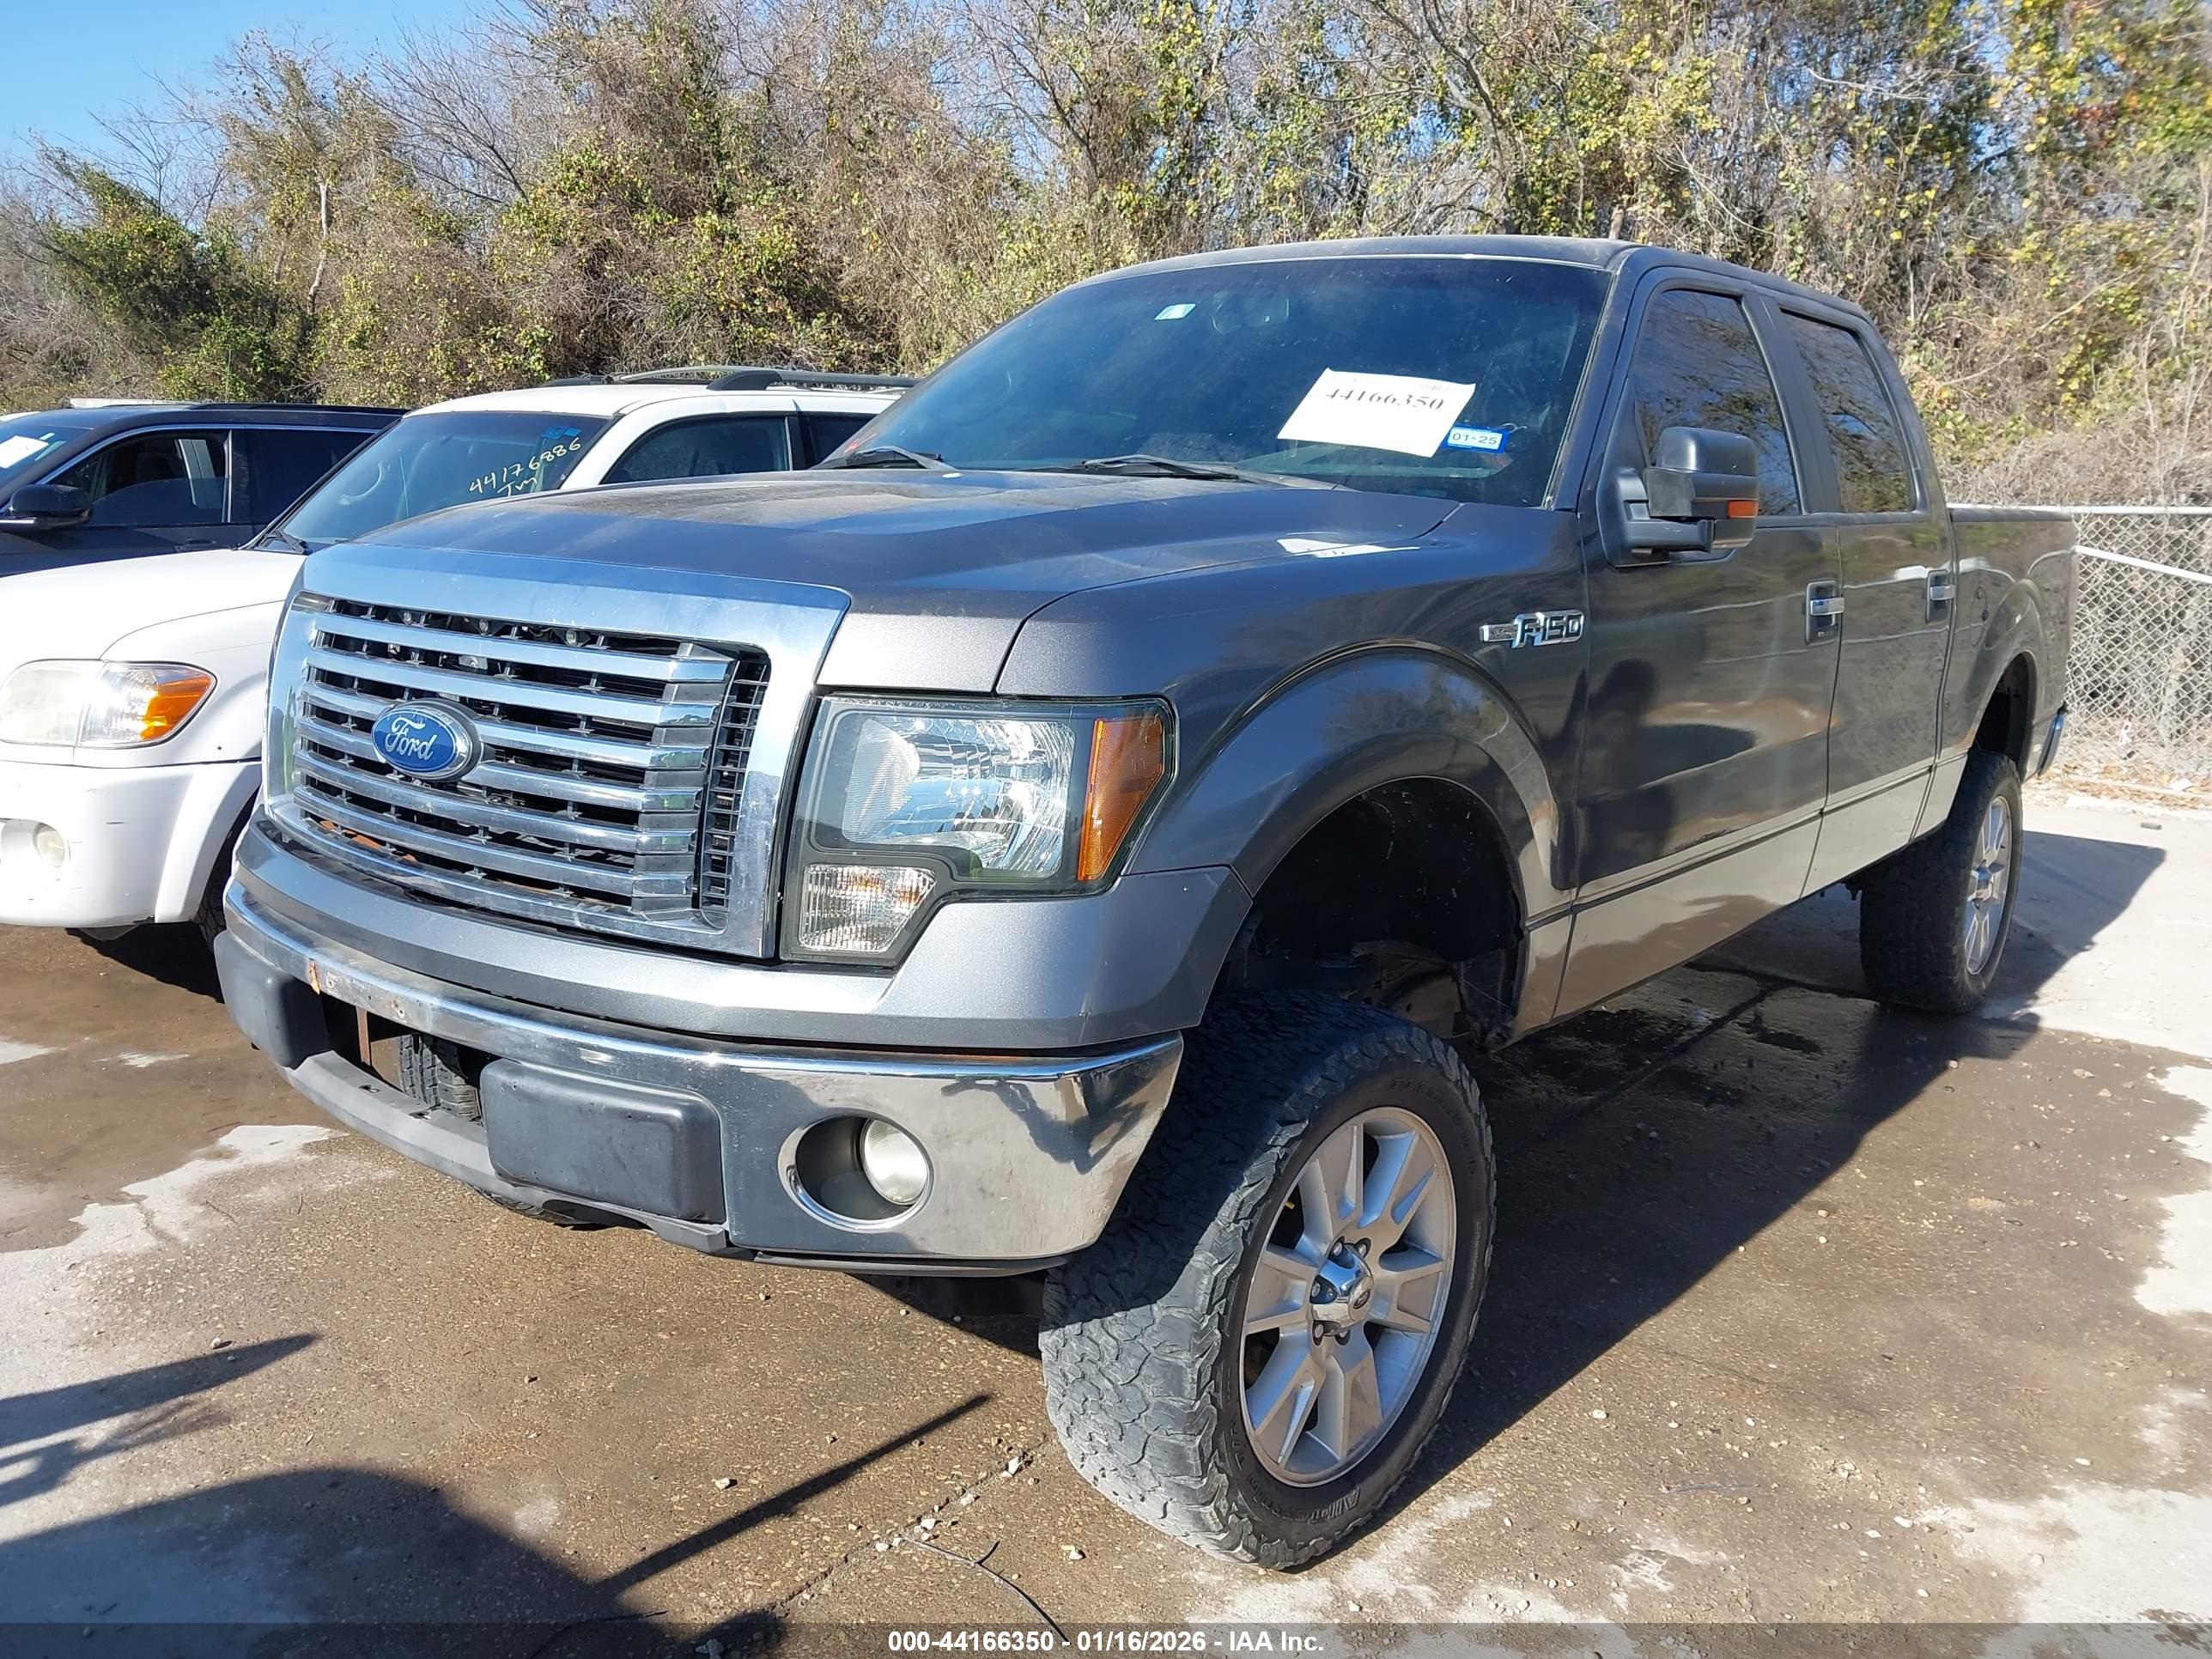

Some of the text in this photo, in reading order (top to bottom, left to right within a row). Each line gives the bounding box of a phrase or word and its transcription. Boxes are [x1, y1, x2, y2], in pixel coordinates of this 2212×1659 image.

[1325, 387, 1444, 411] 44166350
[469, 436, 581, 494] 44176886
[384, 716, 438, 761] Ford
